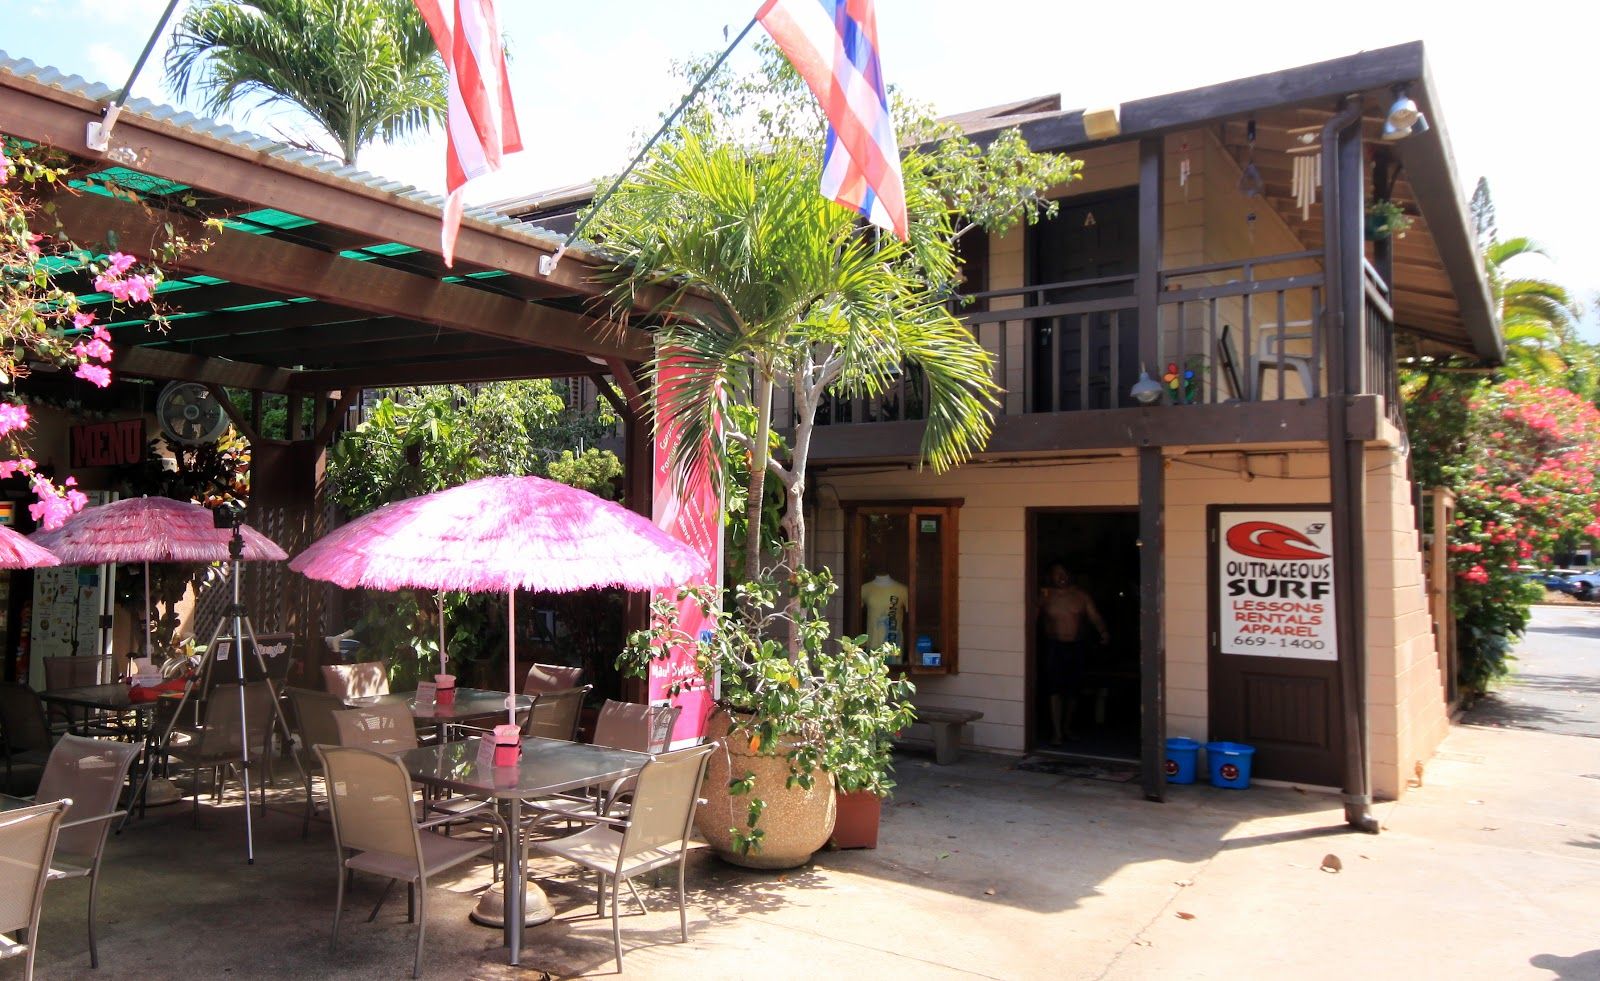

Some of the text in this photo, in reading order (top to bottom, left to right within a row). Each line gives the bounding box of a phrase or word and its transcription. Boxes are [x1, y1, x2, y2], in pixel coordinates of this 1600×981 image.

[73, 420, 142, 466] MENU
[1226, 561, 1330, 579] OUTRAGEOUS
[1226, 578, 1331, 600] SURF
[1233, 600, 1324, 614] LESSONS
[1234, 612, 1322, 625] RENTALS
[1239, 624, 1319, 637] APPAREL
[1233, 636, 1325, 650] 669-1400
[671, 660, 695, 677] Swiss
